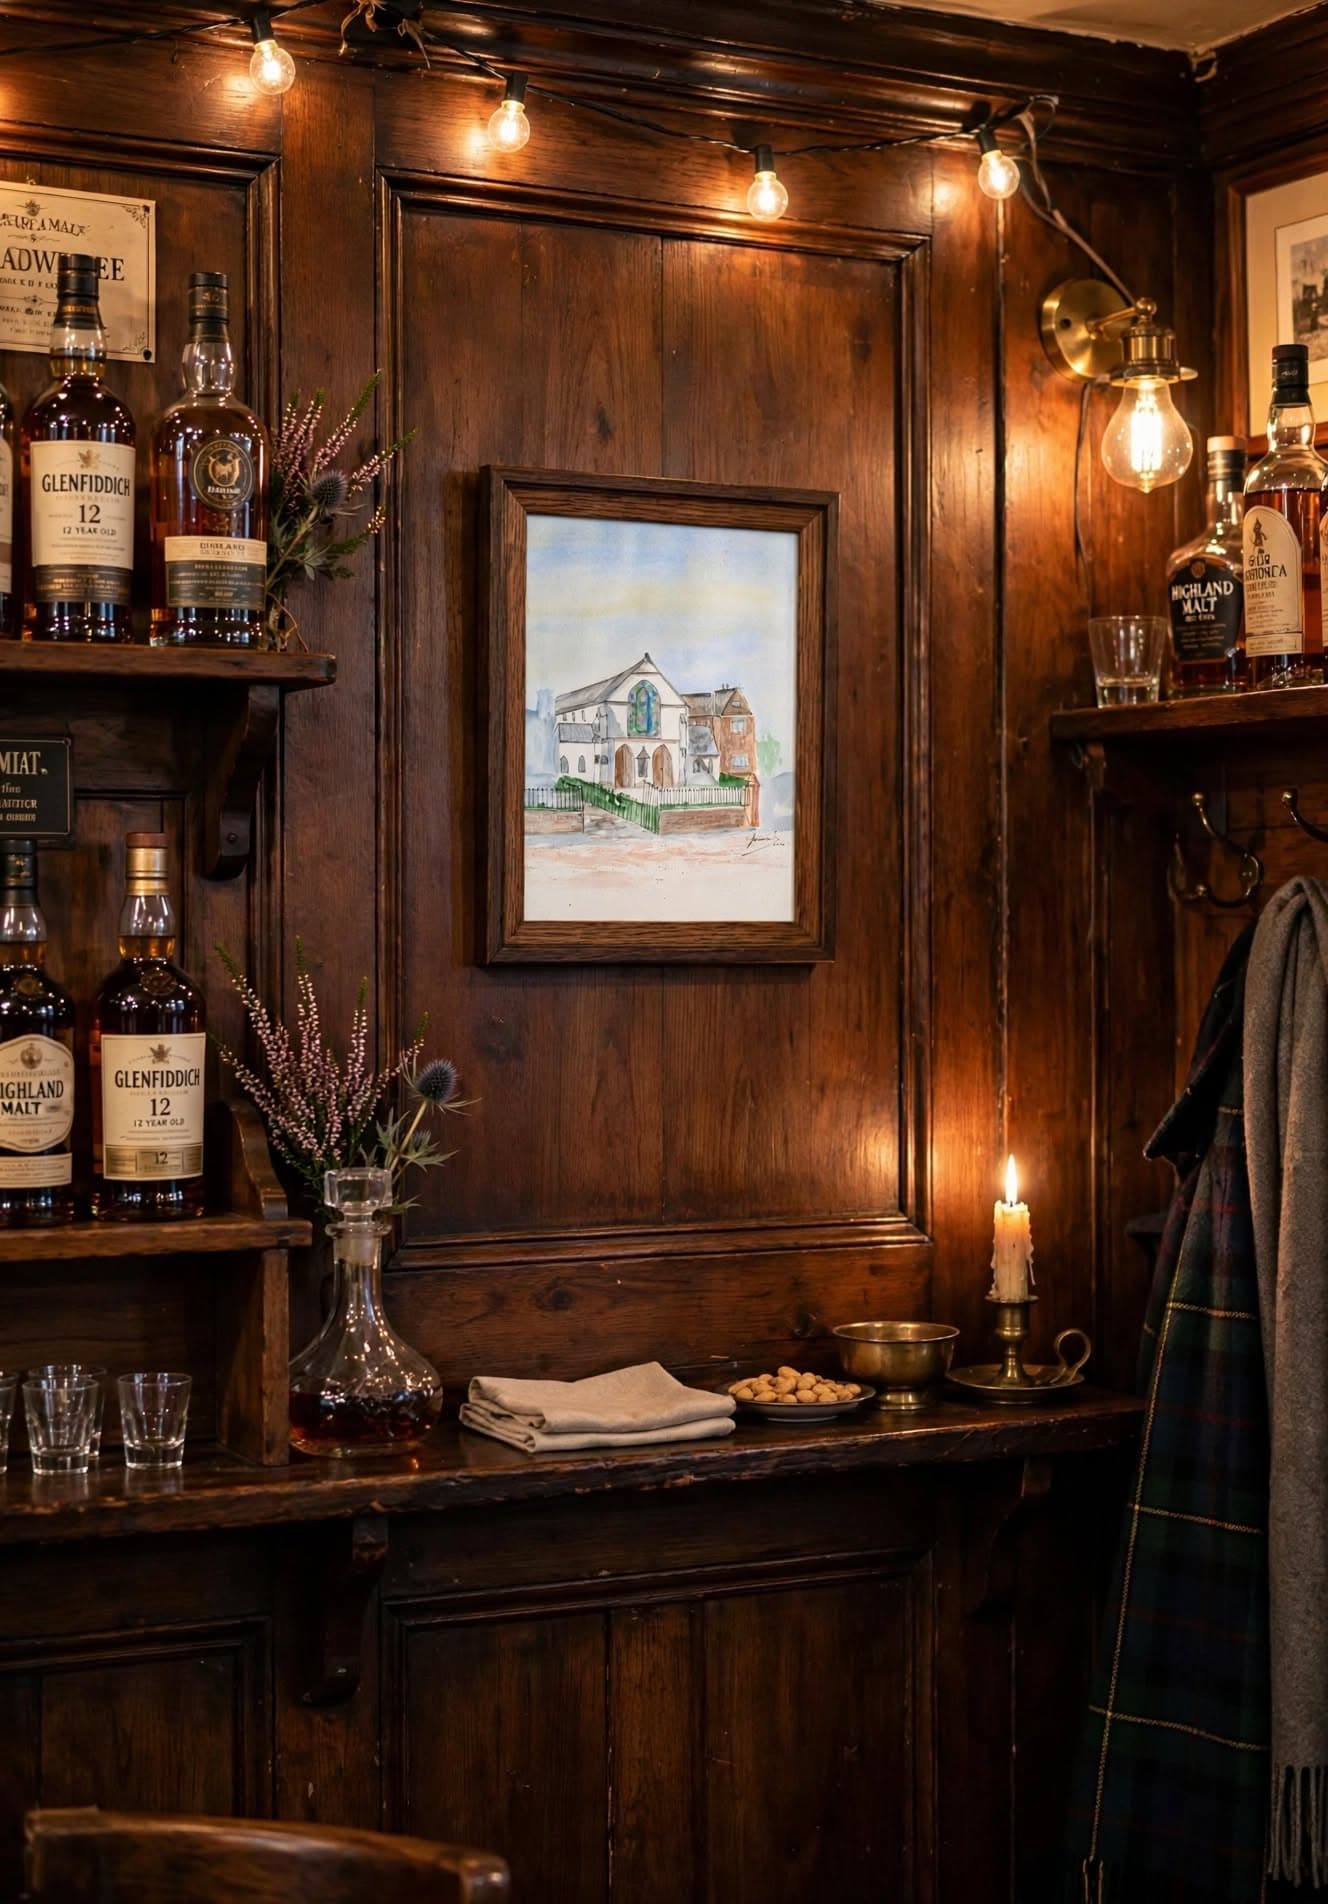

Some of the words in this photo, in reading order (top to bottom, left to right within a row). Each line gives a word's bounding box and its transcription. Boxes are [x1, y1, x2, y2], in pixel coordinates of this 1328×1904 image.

[42, 473, 131, 497] GLENFIDDICH
[79, 504, 101, 523] 12
[1171, 580, 1235, 601] HIGHLAND
[1182, 596, 1218, 616] MALT
[114, 1068, 200, 1089] GLENFIDDICH
[0, 1080, 64, 1099] IGHLAND
[1, 1101, 42, 1116] MALT
[150, 1097, 171, 1116] 12
[134, 1119, 143, 1127] 12
[146, 1119, 167, 1127] YEAR
[170, 1117, 185, 1126] OLD
[154, 1151, 168, 1165] 12
